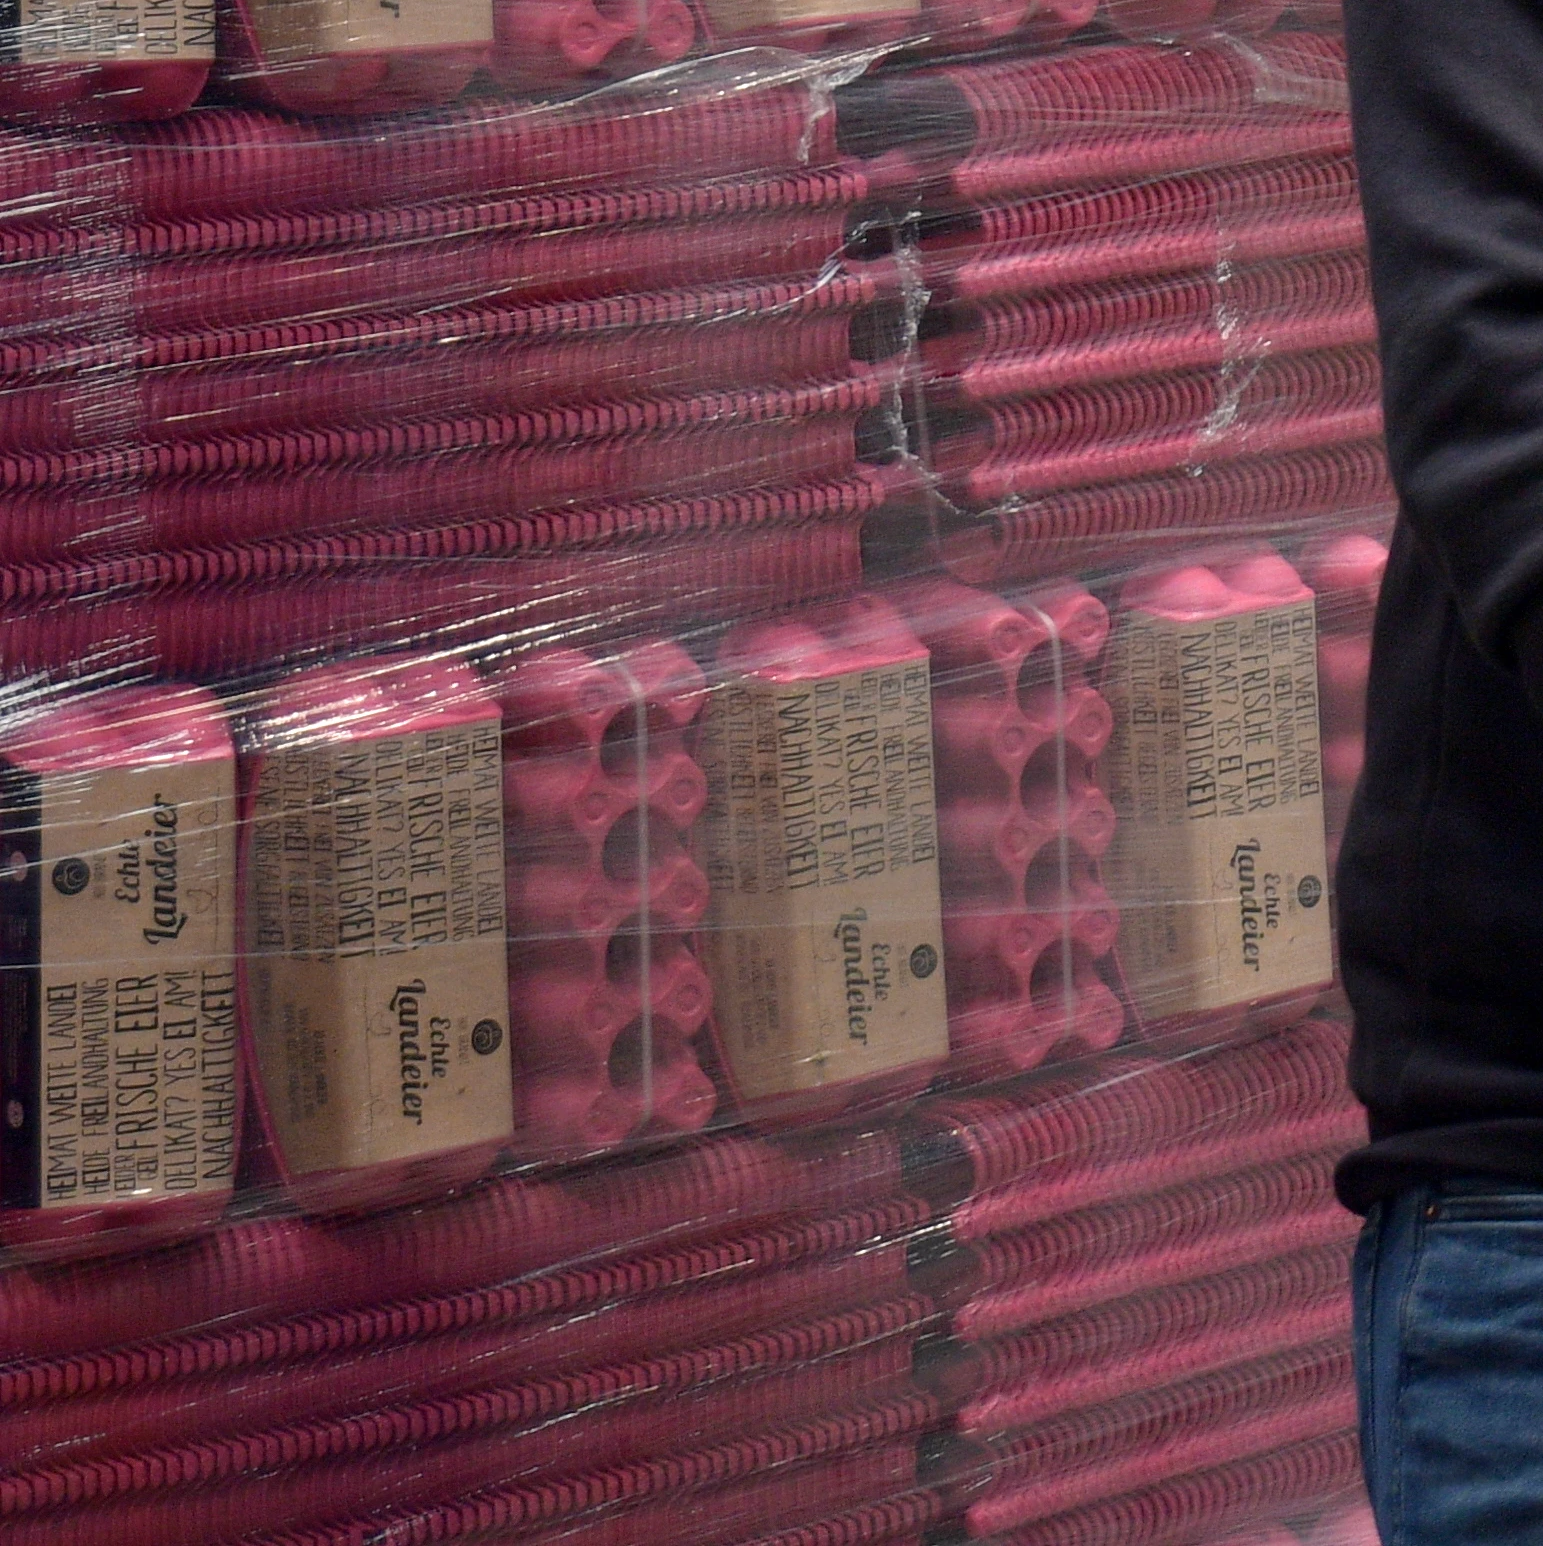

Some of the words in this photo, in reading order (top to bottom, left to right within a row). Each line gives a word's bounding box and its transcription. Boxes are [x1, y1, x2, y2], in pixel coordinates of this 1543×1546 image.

[1182, 631, 1216, 821] NACHHALTIGKEIT
[1240, 654, 1272, 750] FRISCHE
[779, 692, 818, 890] NACHHALTIGKEIT
[844, 714, 880, 815] FRISCHE
[1244, 759, 1274, 812] EIER
[336, 751, 374, 959] NACHHALTIGKEIT
[407, 777, 444, 882] FRISCHE
[849, 823, 884, 879] EIER
[118, 838, 142, 903] Echte
[145, 793, 184, 945] Landeier
[1262, 872, 1280, 930] Echte
[409, 892, 446, 950] EIER
[1231, 838, 1262, 973] Landeier
[116, 975, 158, 1032] EIER
[165, 973, 196, 1009] AM!
[835, 906, 870, 1047] Landeier
[870, 941, 891, 1002] Echte
[47, 982, 77, 1049] LANDEI
[165, 1020, 196, 1039] EI
[428, 1016, 449, 1079] Echte
[83, 978, 111, 1137] FREILANDHALTUNG
[165, 1048, 194, 1085] YES
[196, 972, 236, 1178] NACHHALTIGKEIT
[390, 978, 426, 1127] Landeier
[47, 1061, 77, 1125] WEITE
[114, 1045, 156, 1151] FRISCHE
[47, 1132, 78, 1201] HEIMAT
[82, 1149, 107, 1195] HEIDE
[161, 1096, 195, 1189] DELIKAT?
